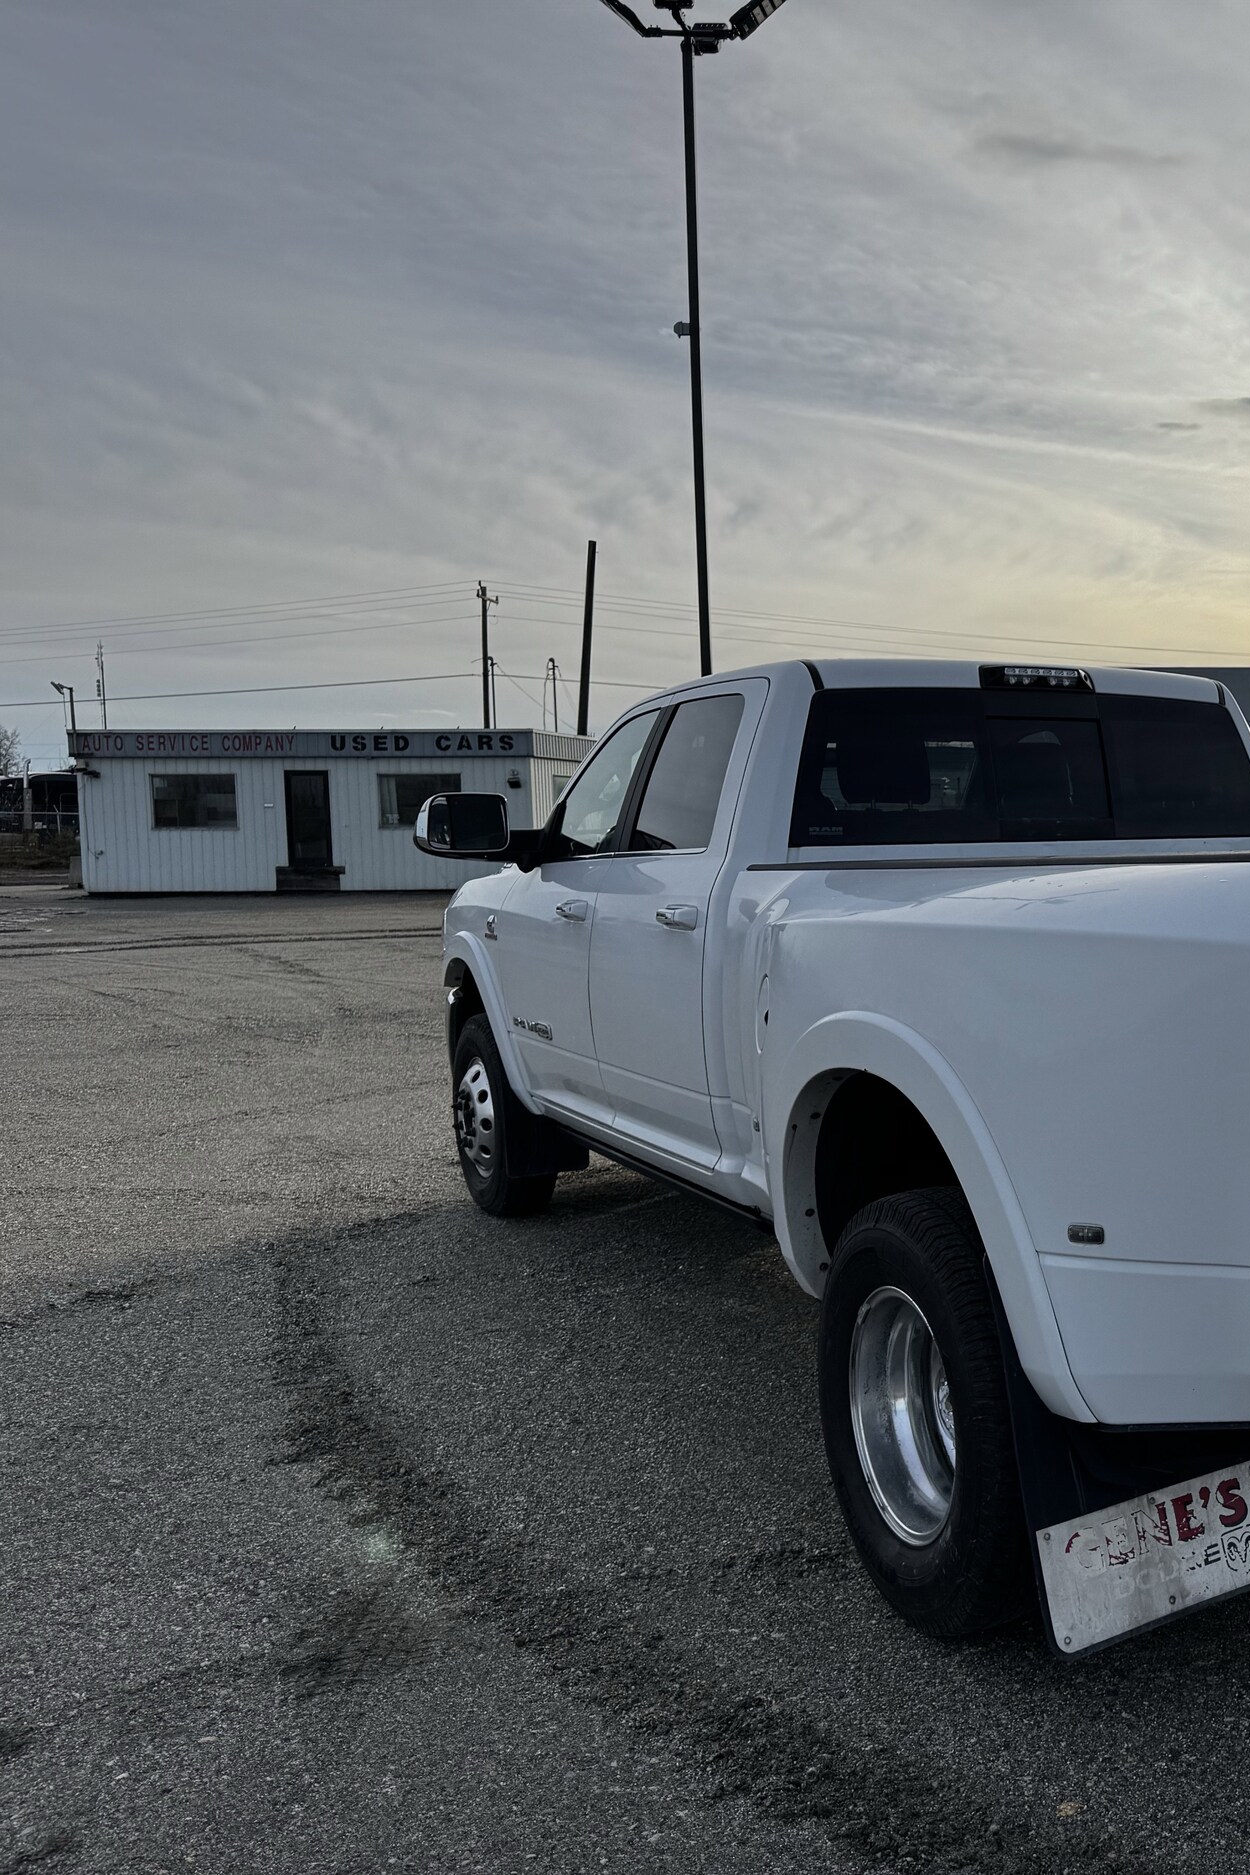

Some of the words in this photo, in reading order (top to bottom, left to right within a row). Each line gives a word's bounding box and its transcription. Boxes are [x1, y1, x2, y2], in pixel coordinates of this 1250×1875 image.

[82, 735, 124, 751] AUTO
[136, 735, 209, 751] SERVICE
[222, 735, 295, 751] COMPANY
[330, 735, 410, 751] USED
[435, 735, 514, 751] CARS
